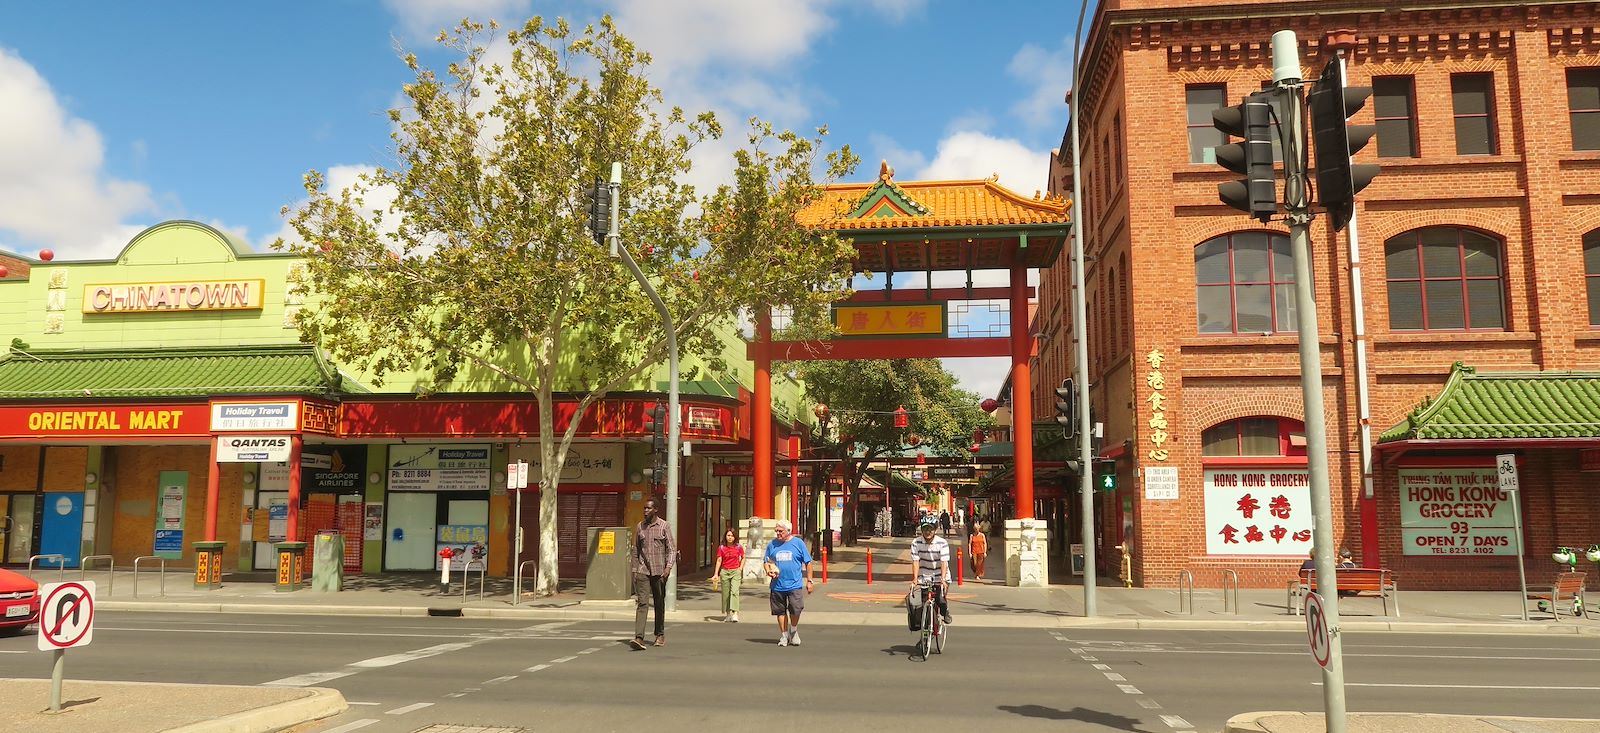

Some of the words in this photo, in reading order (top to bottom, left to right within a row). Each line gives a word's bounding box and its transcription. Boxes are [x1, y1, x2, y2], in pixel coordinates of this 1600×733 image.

[92, 283, 249, 311] CHINATOWN
[849, 311, 927, 331] 唐人街
[225, 407, 257, 416] Holiday
[259, 407, 284, 415] Travel
[1146, 349, 1168, 461] 香港食品中心
[28, 411, 120, 430] ORIENTAL
[129, 410, 183, 430] MART
[231, 439, 286, 447] QANTAS
[442, 450, 464, 458] Holiday
[1214, 474, 1237, 487] HONG
[1242, 474, 1265, 487] KONG
[1270, 474, 1309, 487] GROCERY
[1401, 475, 1430, 485] TRUNG
[1432, 472, 1452, 485] TÂM
[1501, 477, 1517, 487] LANE
[1408, 487, 1455, 501] HONG
[1459, 487, 1508, 501] KONG
[1236, 493, 1291, 519] 香港
[1420, 503, 1497, 518] GROCERY
[1219, 524, 1312, 544] 食品中心
[1450, 522, 1469, 534] 93
[1415, 536, 1455, 546] OPEN
[1460, 536, 1468, 546] 7
[1473, 536, 1509, 546] DAYS
